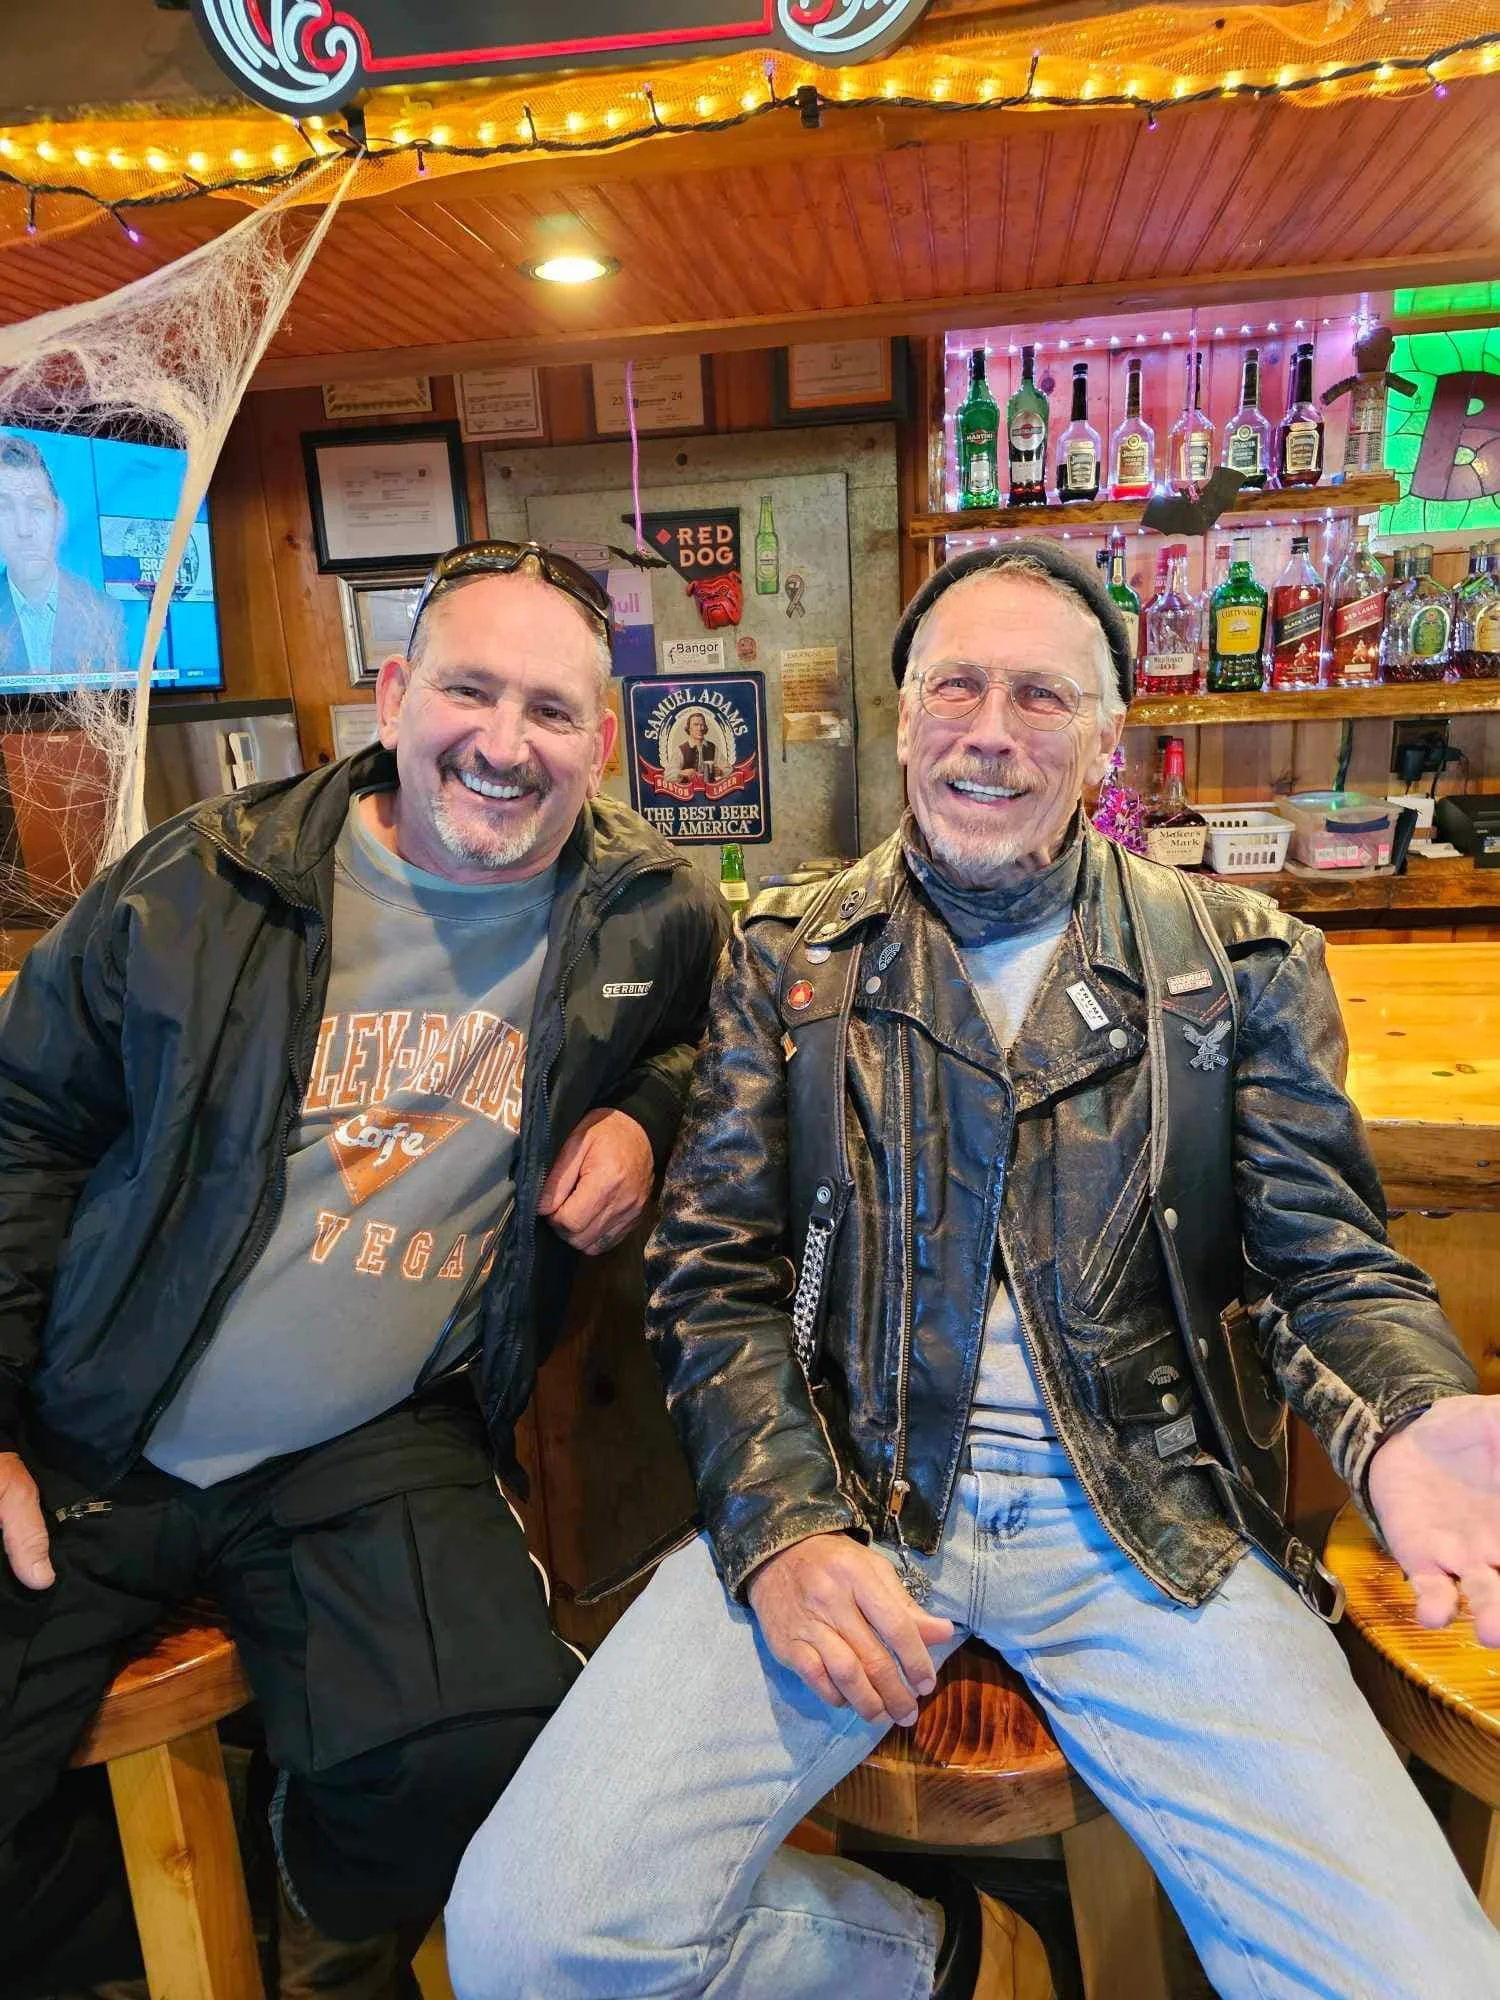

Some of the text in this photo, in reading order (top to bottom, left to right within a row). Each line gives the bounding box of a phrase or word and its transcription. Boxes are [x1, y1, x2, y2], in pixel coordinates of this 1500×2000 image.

[612, 391, 683, 406] 23 24
[677, 525, 734, 547] RED
[679, 546, 734, 568] DOG
[676, 643, 719, 655] Bangor
[644, 688, 748, 741] SAMUEL ADAMS
[656, 778, 738, 797] BOSTON LAGER
[644, 804, 760, 821] THE BEST BEER
[656, 822, 674, 835] IN
[1170, 838, 1200, 847] Mark
[1079, 987, 1104, 1021] TRUMP
